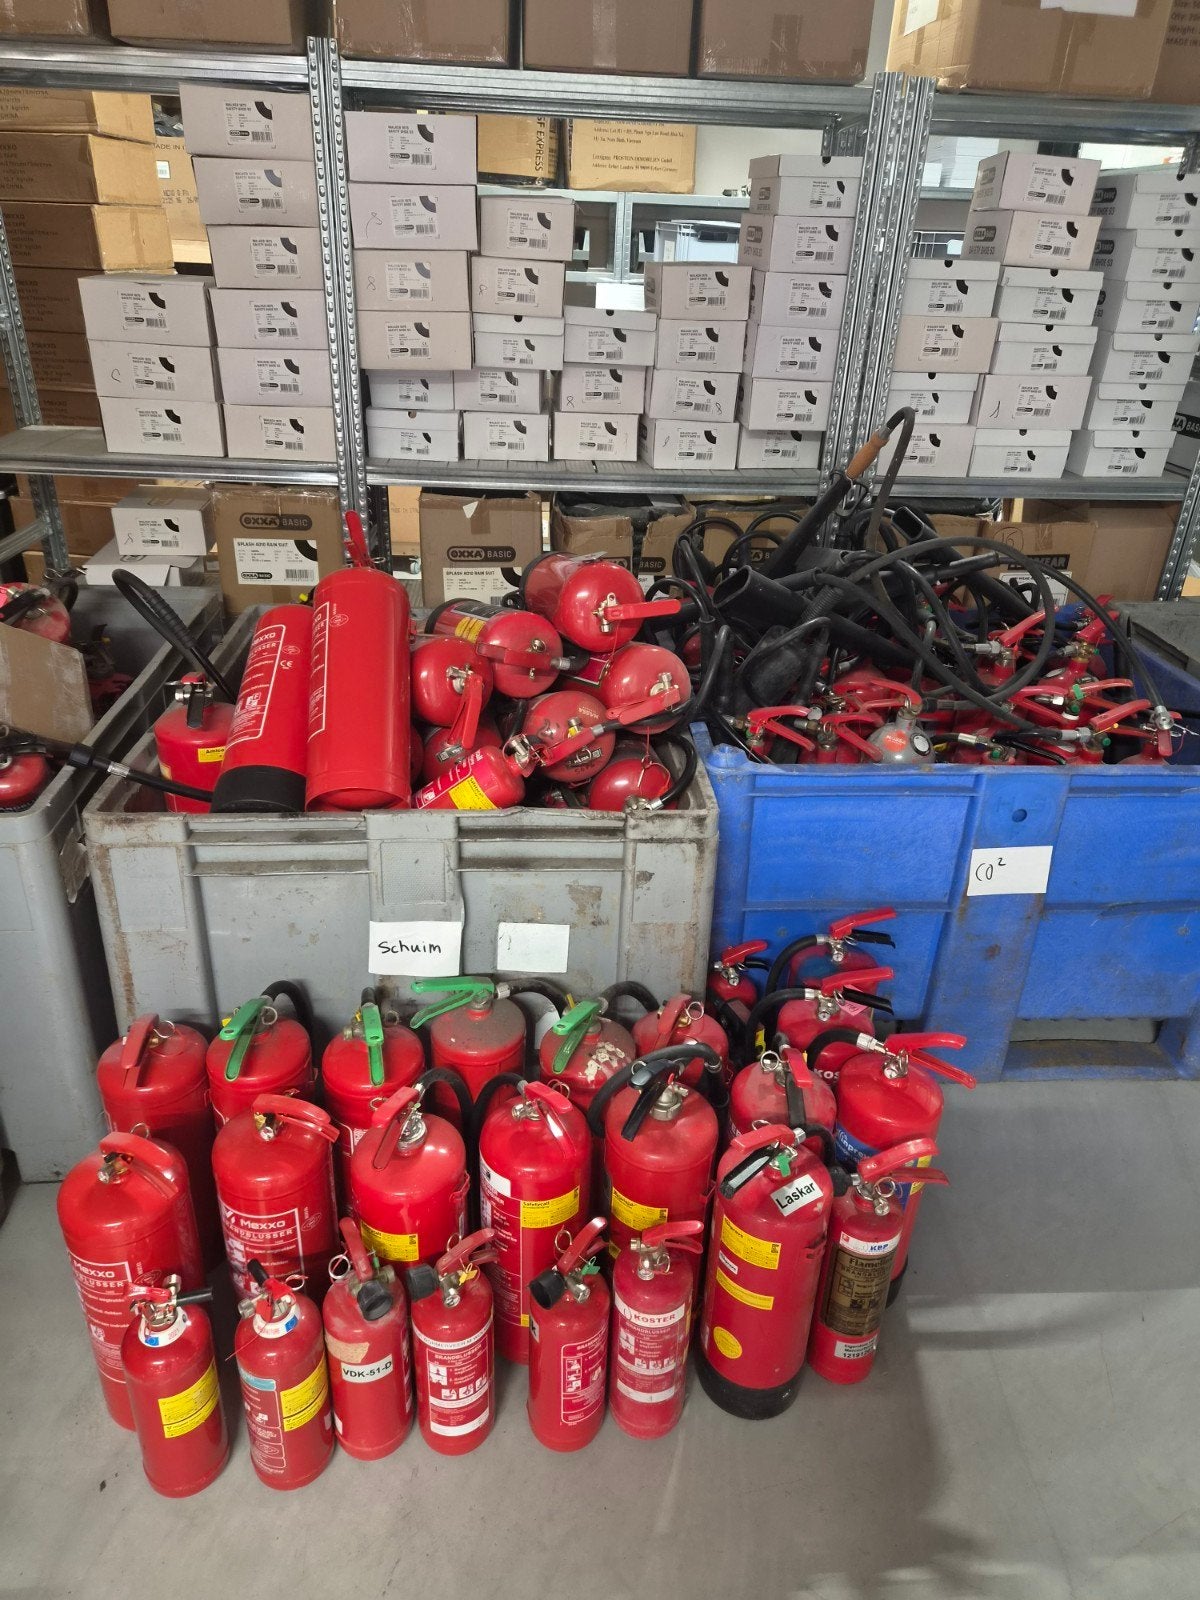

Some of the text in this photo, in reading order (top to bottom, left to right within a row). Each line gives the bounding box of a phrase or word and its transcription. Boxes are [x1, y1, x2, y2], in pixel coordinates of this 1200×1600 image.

[535, 130, 545, 172] EXPRESS
[244, 516, 278, 525] OXXA
[450, 550, 482, 558] OXXA
[378, 940, 442, 954] Schuim
[814, 1068, 839, 1079] KOS
[775, 1182, 815, 1209] Laskar
[240, 1218, 286, 1230] Mexxo
[74, 1260, 115, 1278] Mexxo
[634, 1314, 675, 1323] KOSTER
[342, 1361, 392, 1377] VDK-51-D
